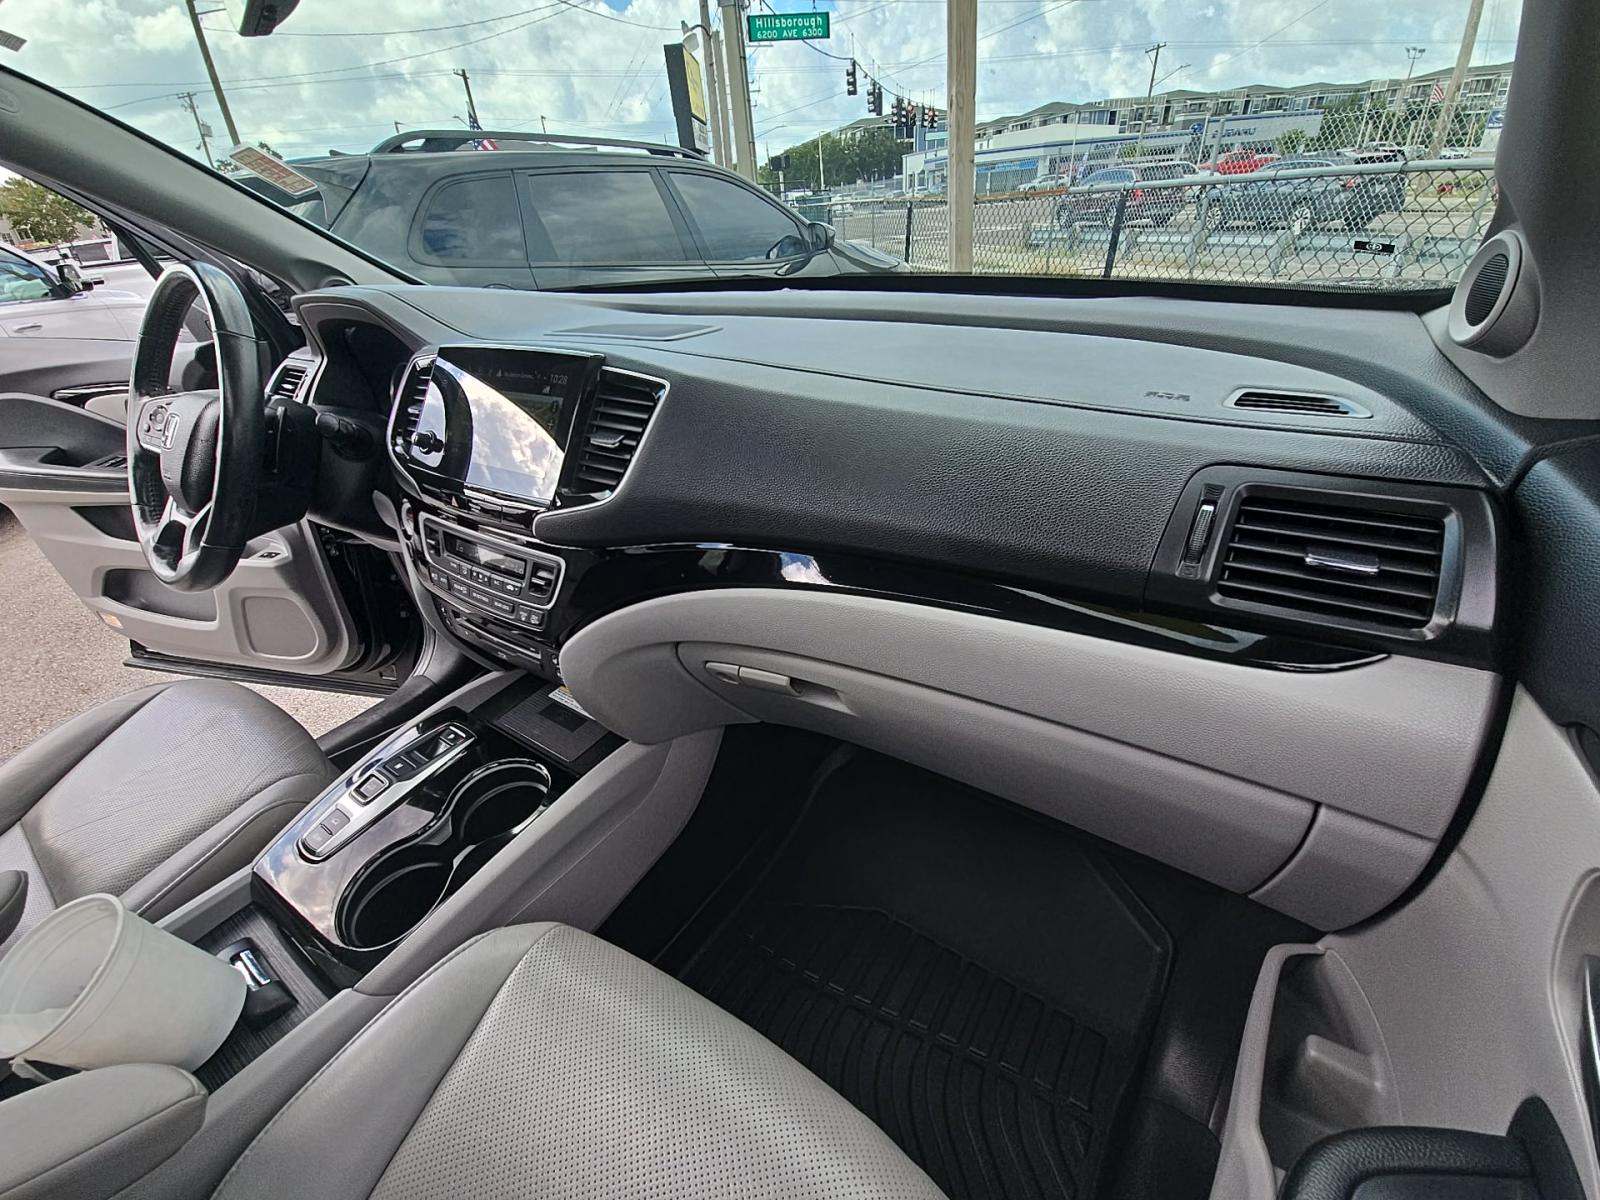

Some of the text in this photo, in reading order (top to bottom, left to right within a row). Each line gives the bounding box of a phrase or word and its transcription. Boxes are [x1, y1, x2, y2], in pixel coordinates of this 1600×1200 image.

[755, 16, 822, 28] Hillsborough
[757, 28, 823, 39] 6200 AVE 6300
